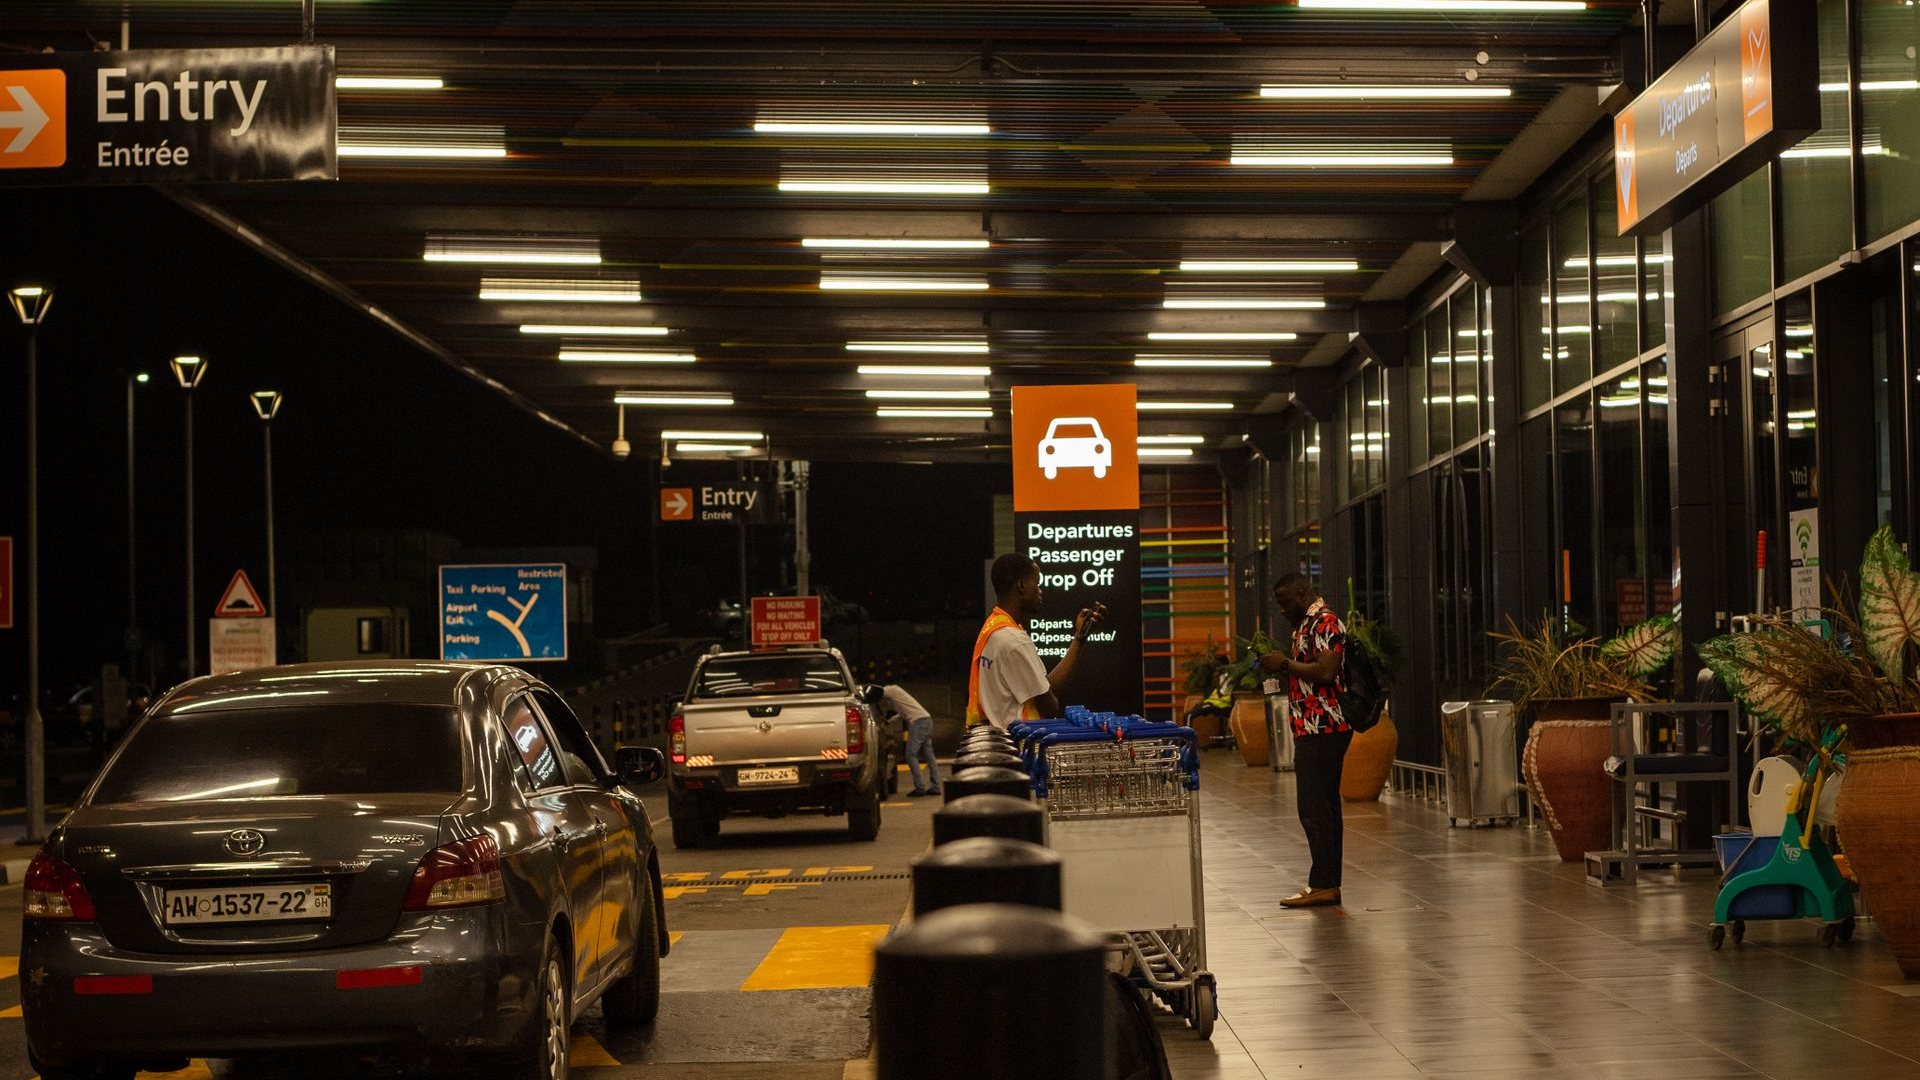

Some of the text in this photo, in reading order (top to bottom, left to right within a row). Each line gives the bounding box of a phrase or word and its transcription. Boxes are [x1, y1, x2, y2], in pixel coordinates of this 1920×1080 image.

[97, 67, 267, 137] Entry
[1658, 70, 1712, 141] Departures
[97, 139, 189, 168] Entrée
[1675, 142, 1698, 175] Départs
[701, 486, 757, 510] Entry
[702, 510, 733, 520] Entrée
[1027, 522, 1133, 543] Departures
[1028, 547, 1124, 566] Passenger
[517, 569, 563, 579] Restricted
[1082, 568, 1114, 587] Off
[446, 584, 506, 595] Taxi Parking
[518, 582, 541, 591] Area
[446, 603, 478, 613] Airport
[766, 600, 805, 609] NO PARKING
[446, 615, 464, 625] Exit
[766, 610, 806, 620] NO WAITING
[771, 622, 784, 630] ALL
[784, 621, 816, 630] VEHICLES
[1030, 619, 1073, 631] Départs
[446, 634, 480, 645] Parking
[780, 632, 793, 641] OFF
[793, 631, 811, 640] ONLY
[1030, 630, 1117, 645] Dépose-nute/
[1035, 646, 1070, 658] assag
[172, 891, 328, 918] AW 1537-22 GH
